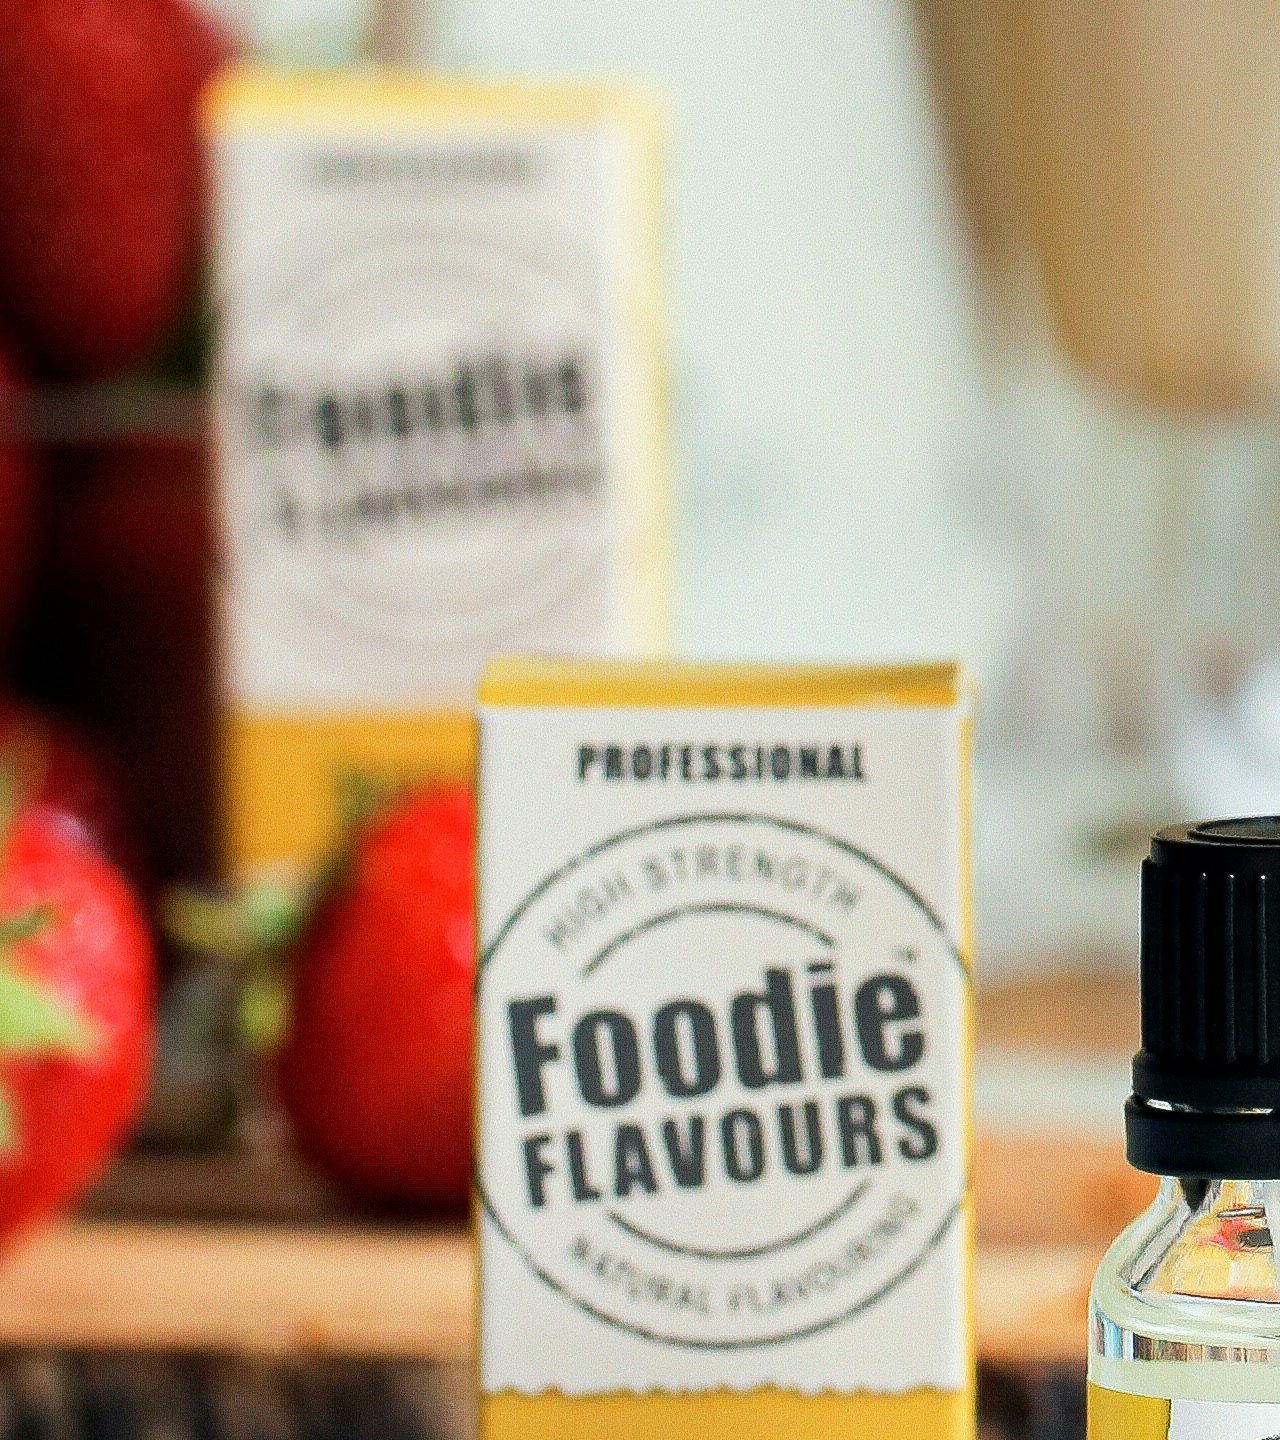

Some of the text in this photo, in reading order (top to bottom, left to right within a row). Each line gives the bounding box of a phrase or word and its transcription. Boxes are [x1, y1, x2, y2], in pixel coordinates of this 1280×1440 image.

[576, 742, 866, 783] PROFESSIONAL
[543, 843, 861, 952] HIGH STRENGTH
[507, 961, 927, 1117] Foodie
[523, 1085, 939, 1209] FLAVOURS
